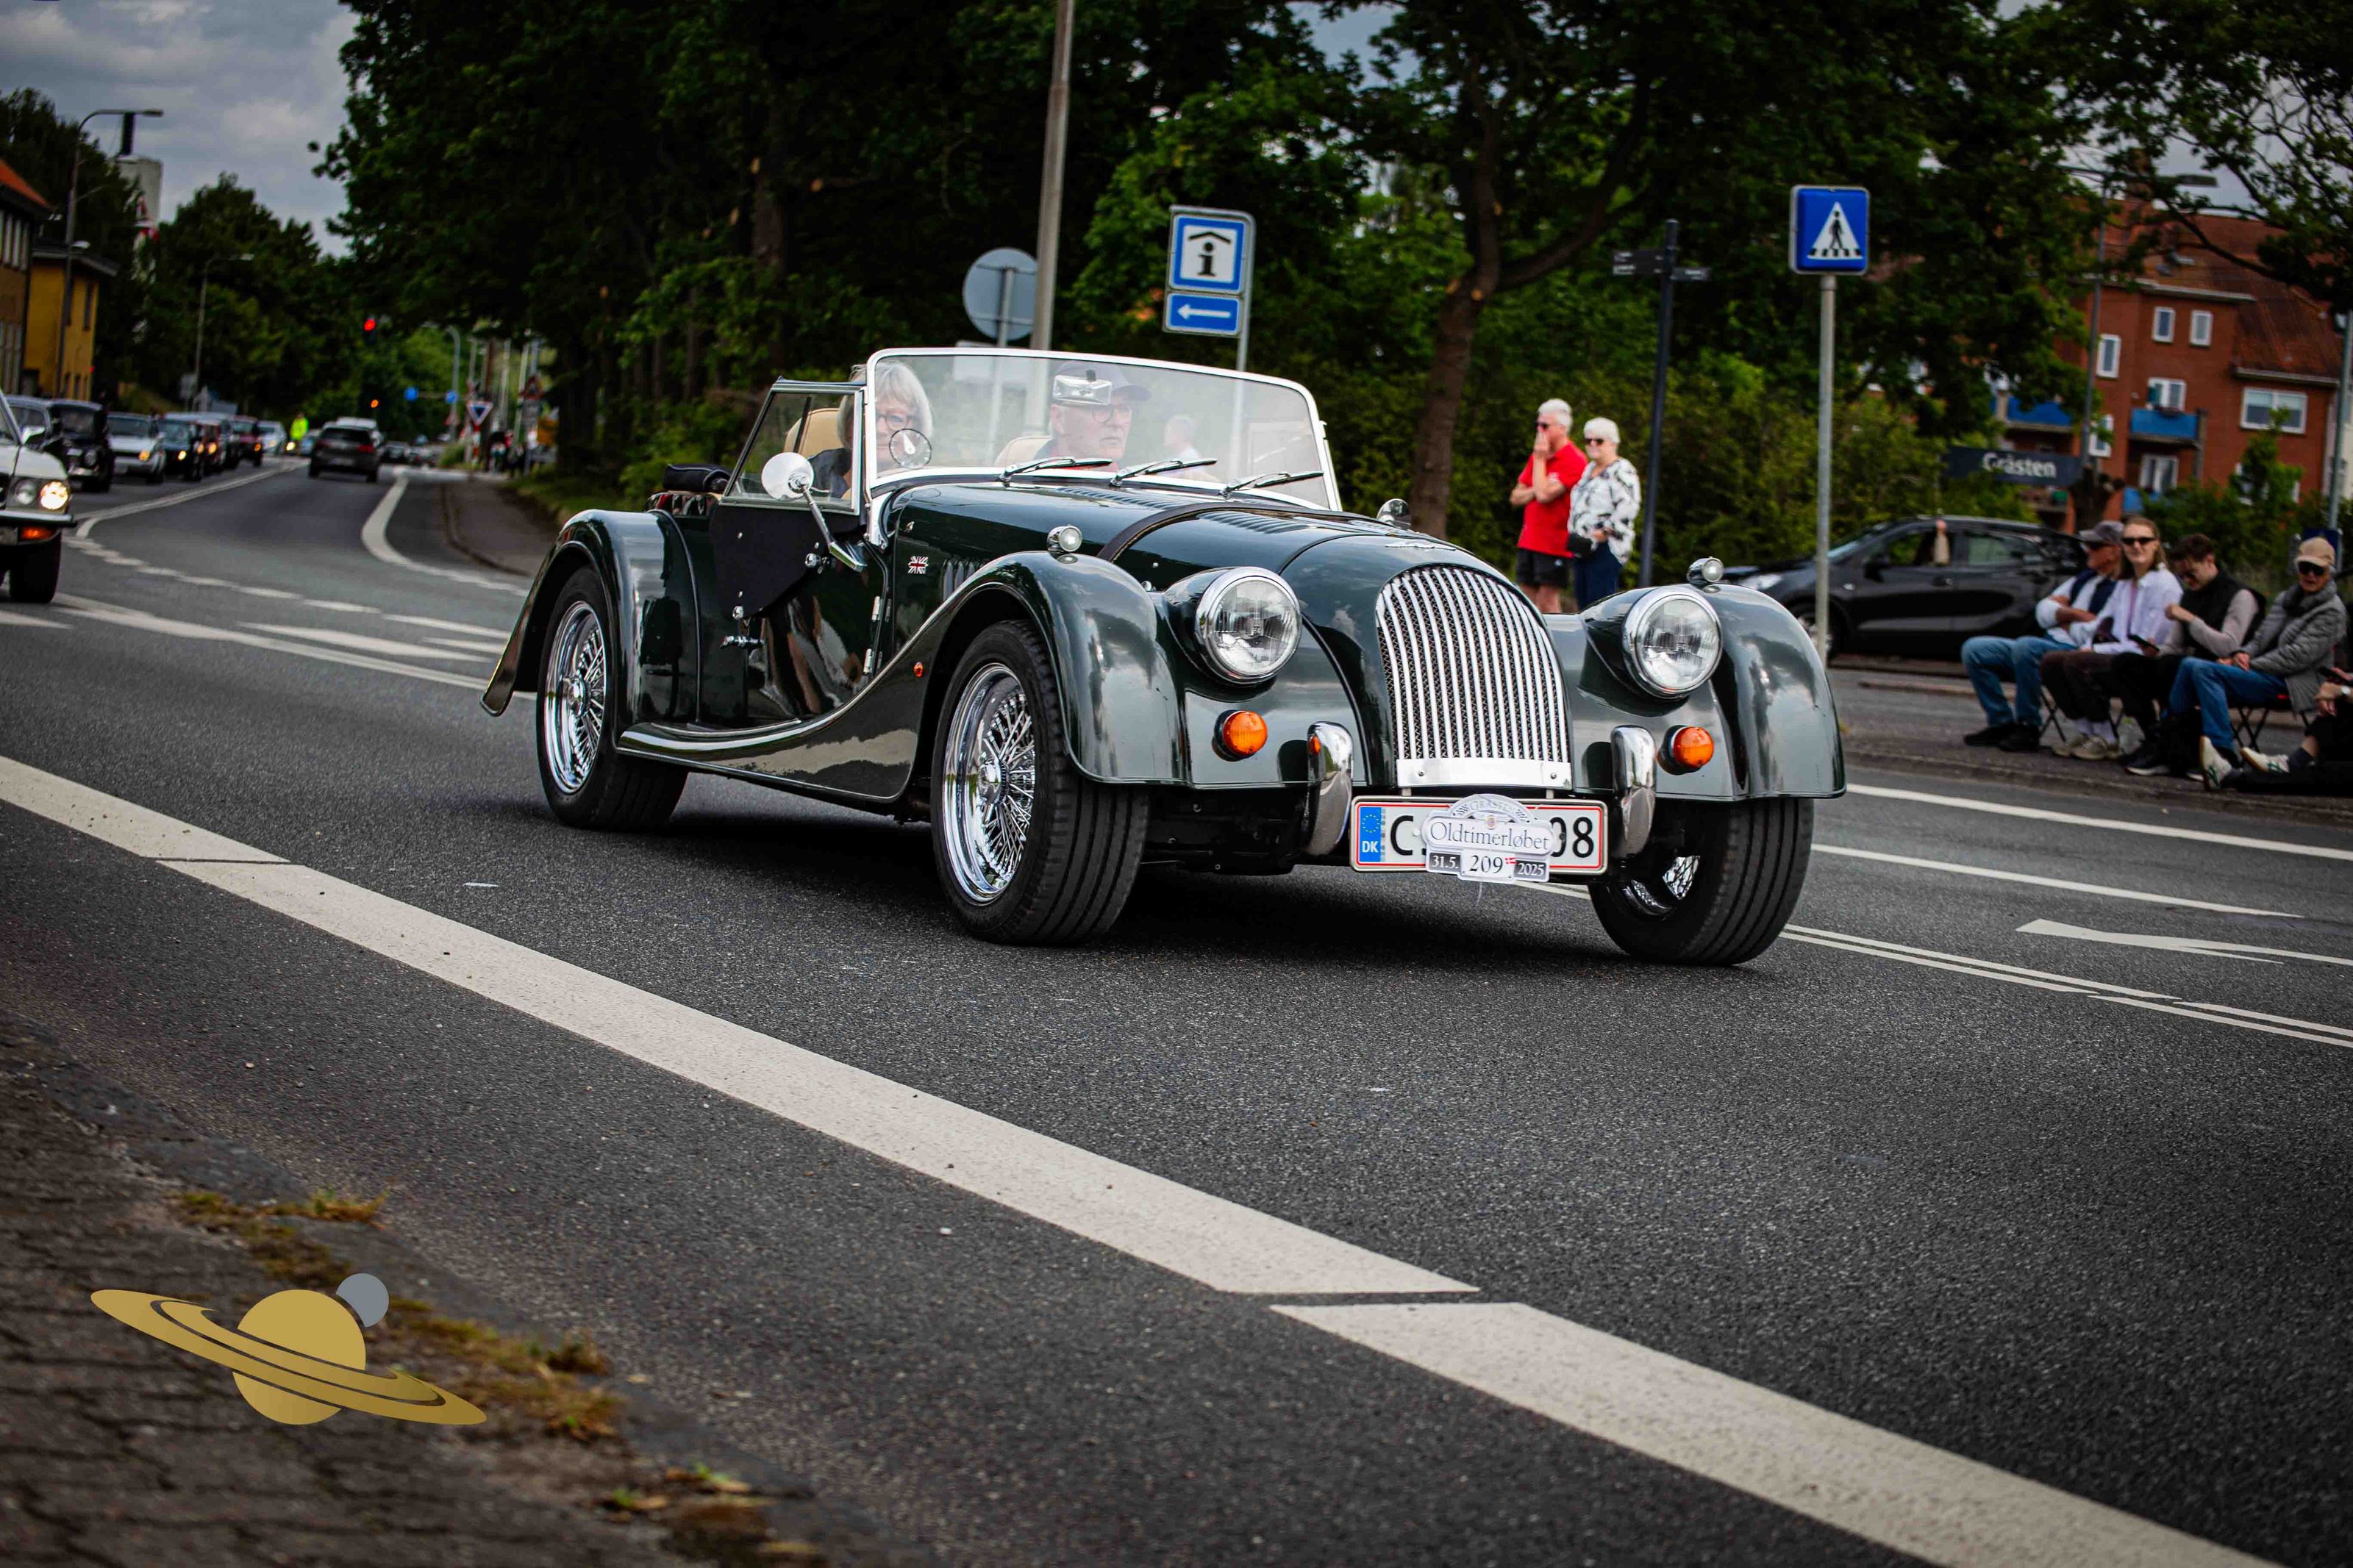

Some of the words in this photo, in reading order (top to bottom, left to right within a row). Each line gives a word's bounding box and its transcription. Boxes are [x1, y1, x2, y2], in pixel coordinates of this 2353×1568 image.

[1362, 840, 1379, 853] DK
[1430, 820, 1550, 851] Oldtimerløbet
[1432, 855, 1459, 870] 31.5.
[1469, 854, 1503, 874] 209
[1517, 862, 1545, 876] 2025
